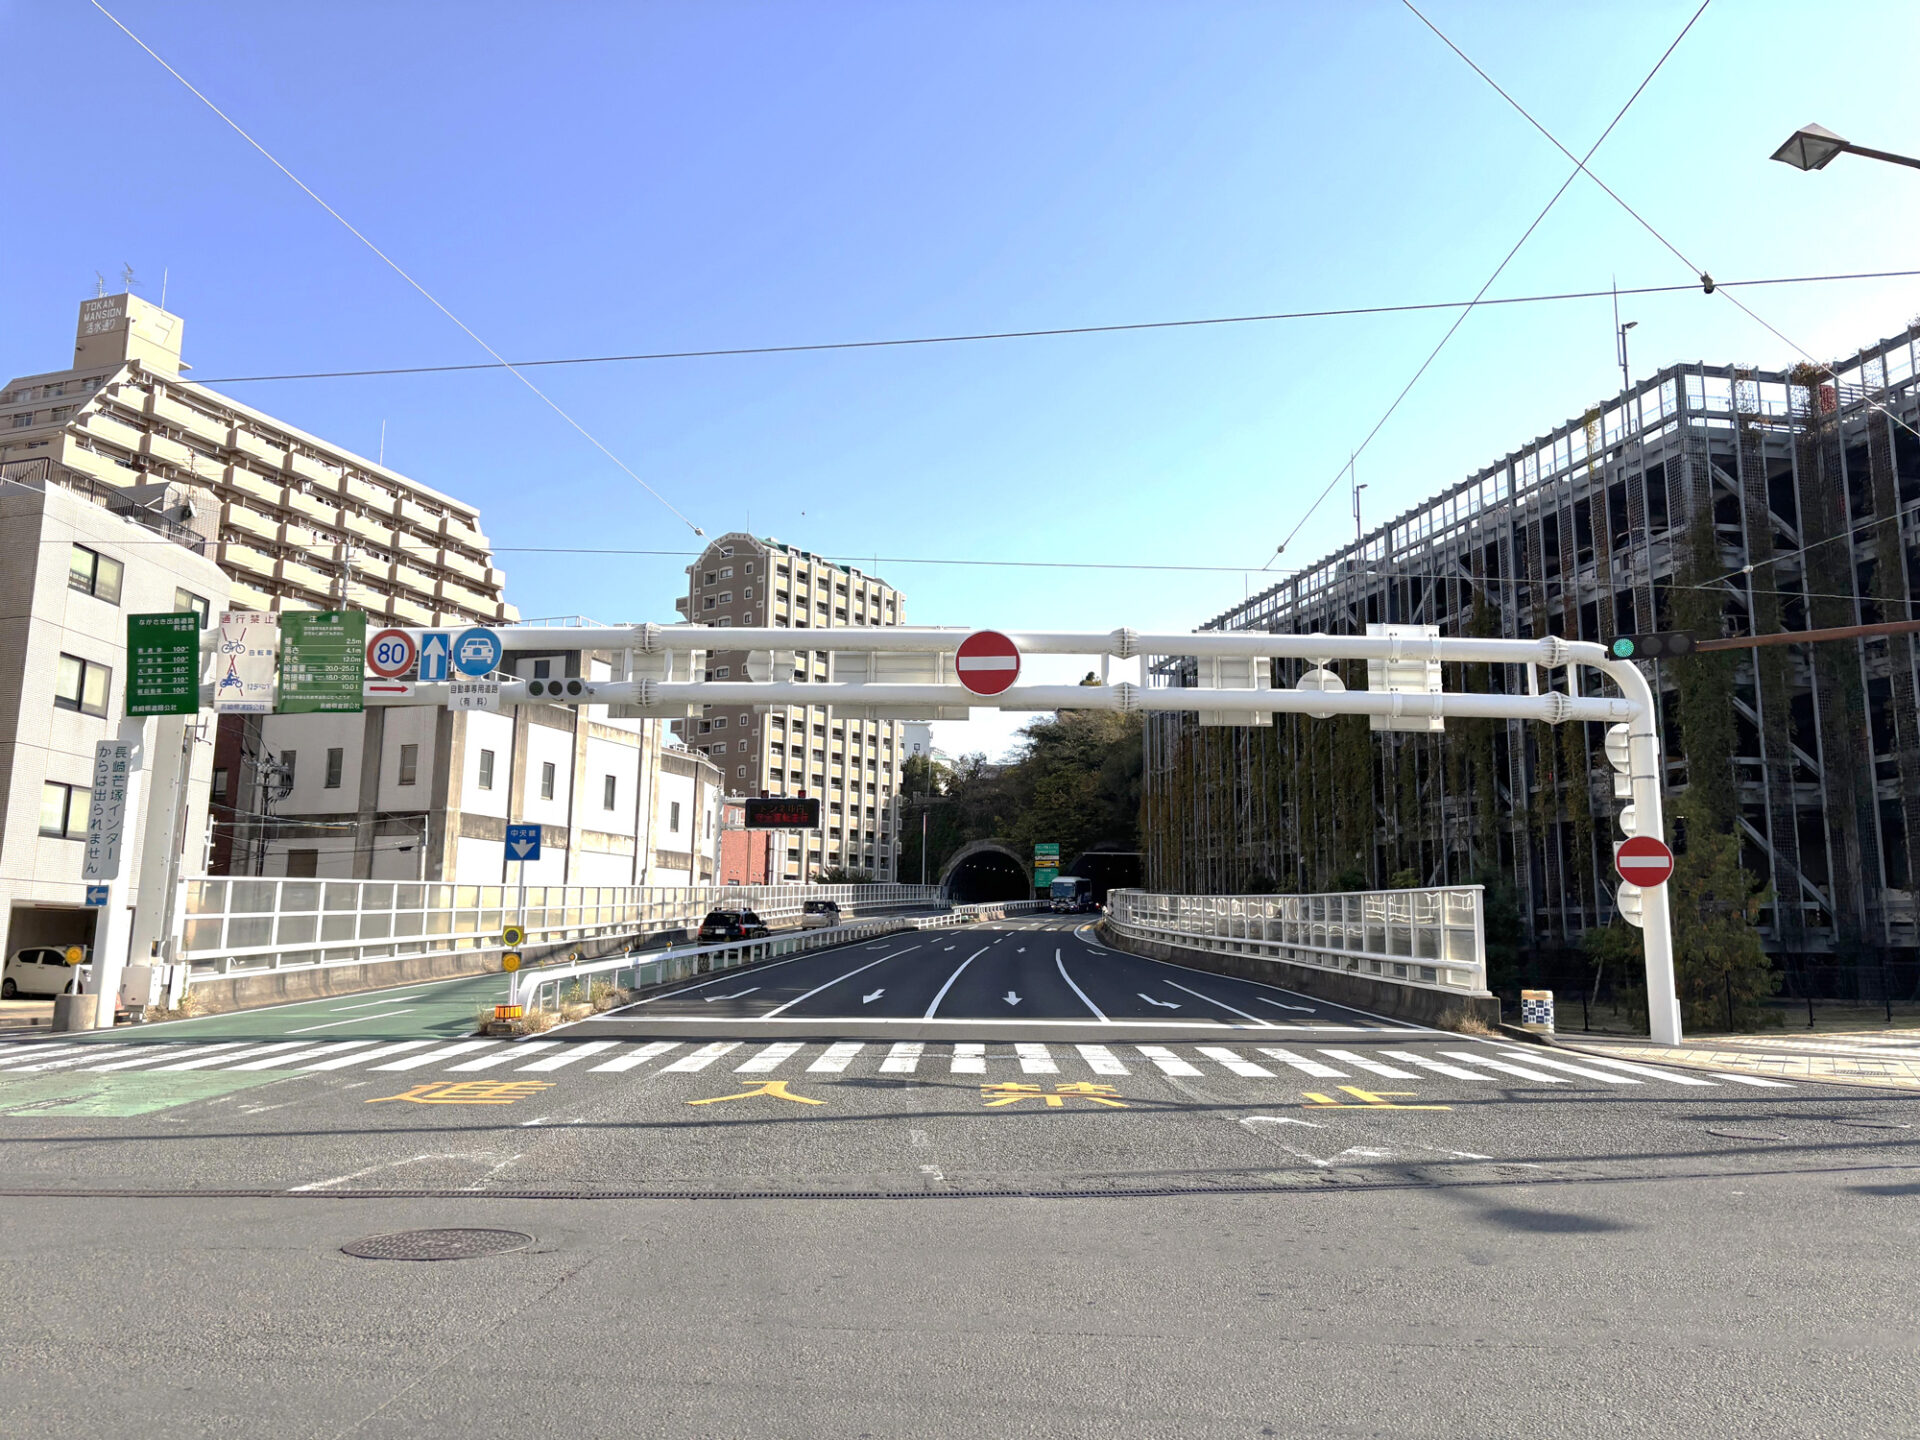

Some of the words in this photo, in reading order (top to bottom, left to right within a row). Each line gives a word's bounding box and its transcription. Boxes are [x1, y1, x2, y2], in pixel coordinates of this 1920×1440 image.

[86, 298, 115, 312] TOKAN
[84, 306, 122, 321] MANSION
[221, 614, 274, 624] 通行禁止
[377, 643, 405, 664] 80
[450, 684, 498, 694] 自動車専用道路
[86, 746, 111, 874] からは出られません
[106, 746, 128, 860] 長崎芒塚インター
